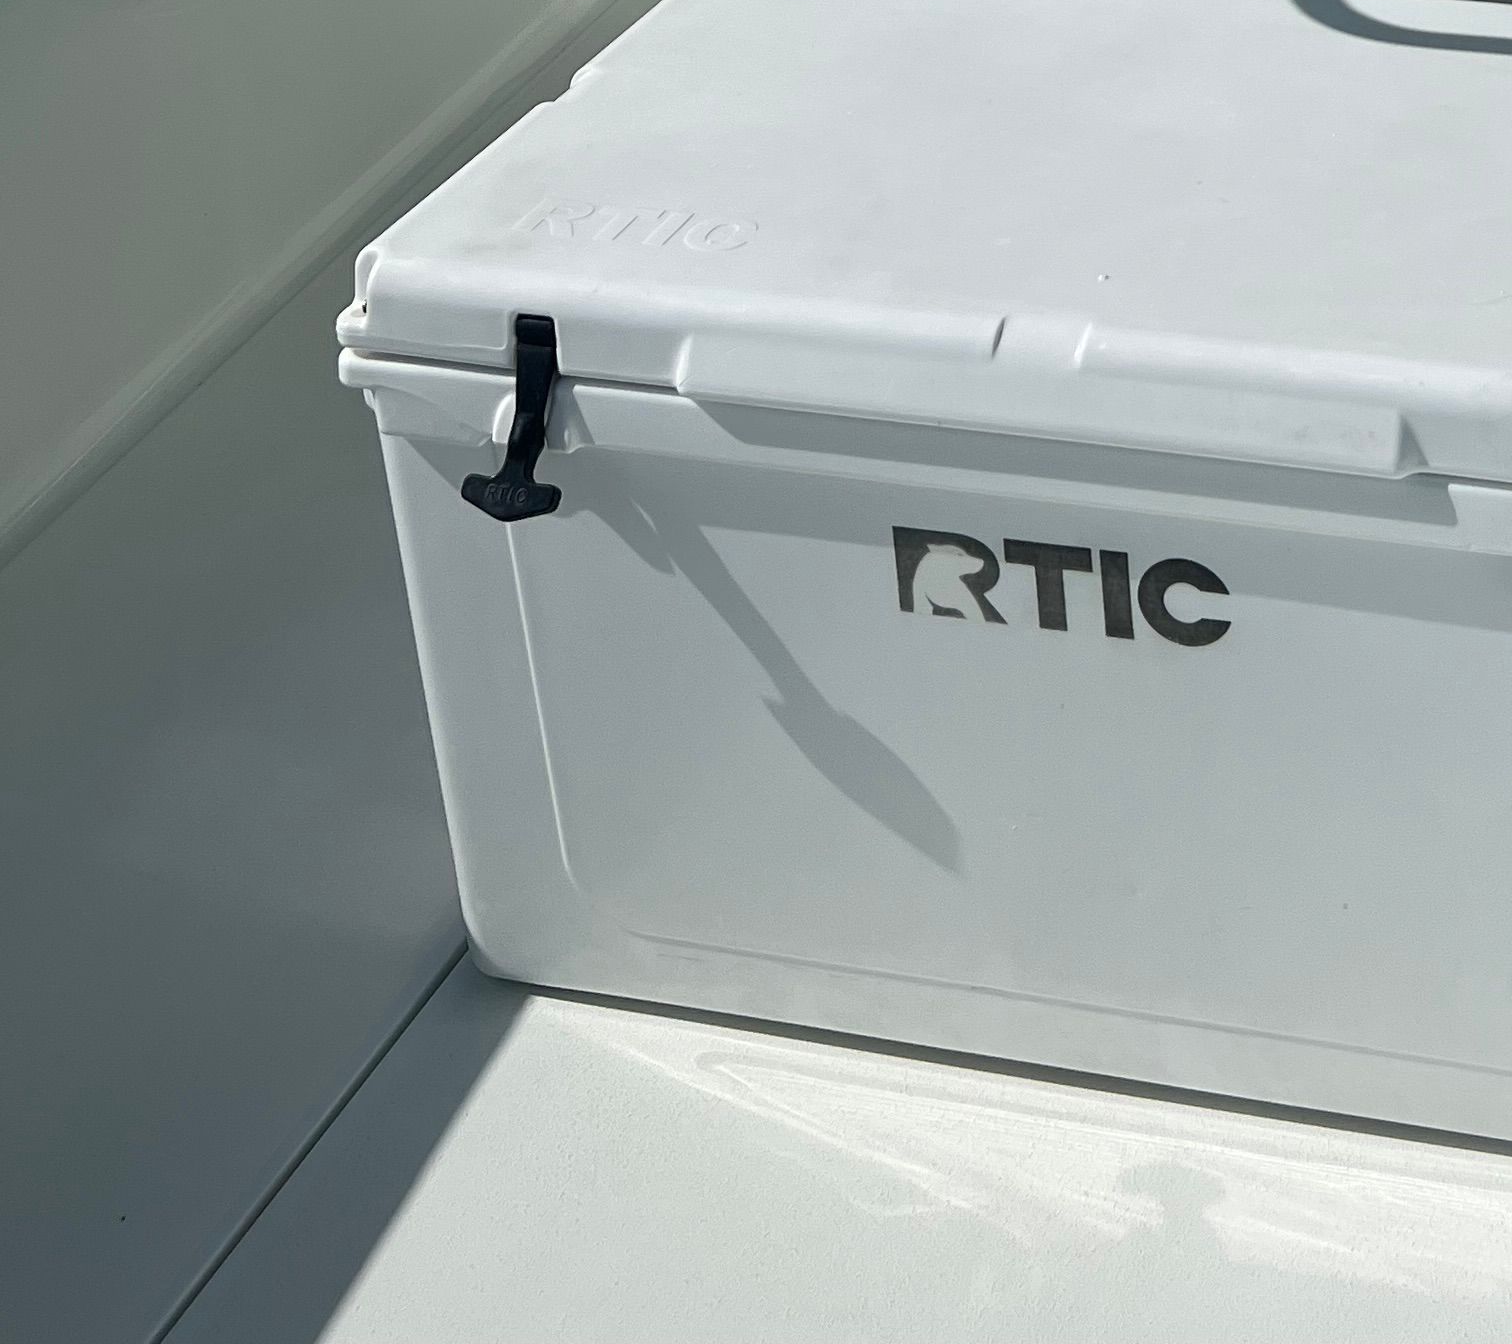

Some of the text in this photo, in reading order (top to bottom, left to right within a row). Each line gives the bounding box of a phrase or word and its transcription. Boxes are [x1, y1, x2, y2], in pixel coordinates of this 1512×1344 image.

[511, 198, 760, 252] RTIC
[484, 483, 528, 505] RTIC
[892, 525, 1231, 646] RTIC
